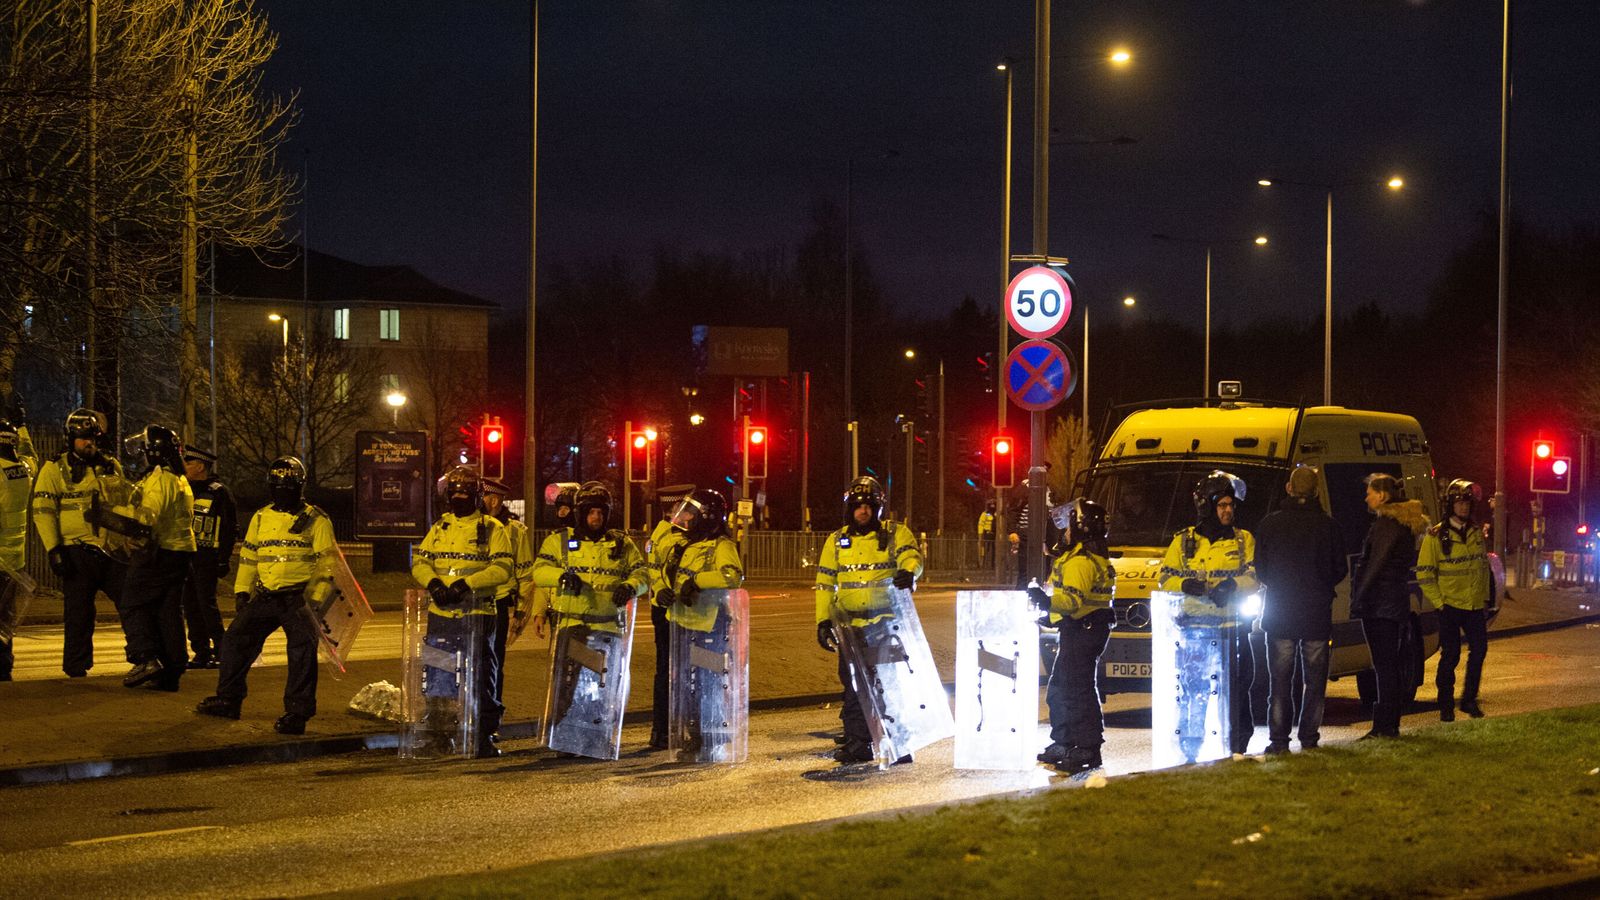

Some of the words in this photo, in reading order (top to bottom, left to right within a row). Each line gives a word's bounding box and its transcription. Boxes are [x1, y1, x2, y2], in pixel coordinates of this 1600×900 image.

[1017, 289, 1061, 317] 50
[1360, 432, 1422, 456] POLICE
[1114, 570, 1158, 579] POLI
